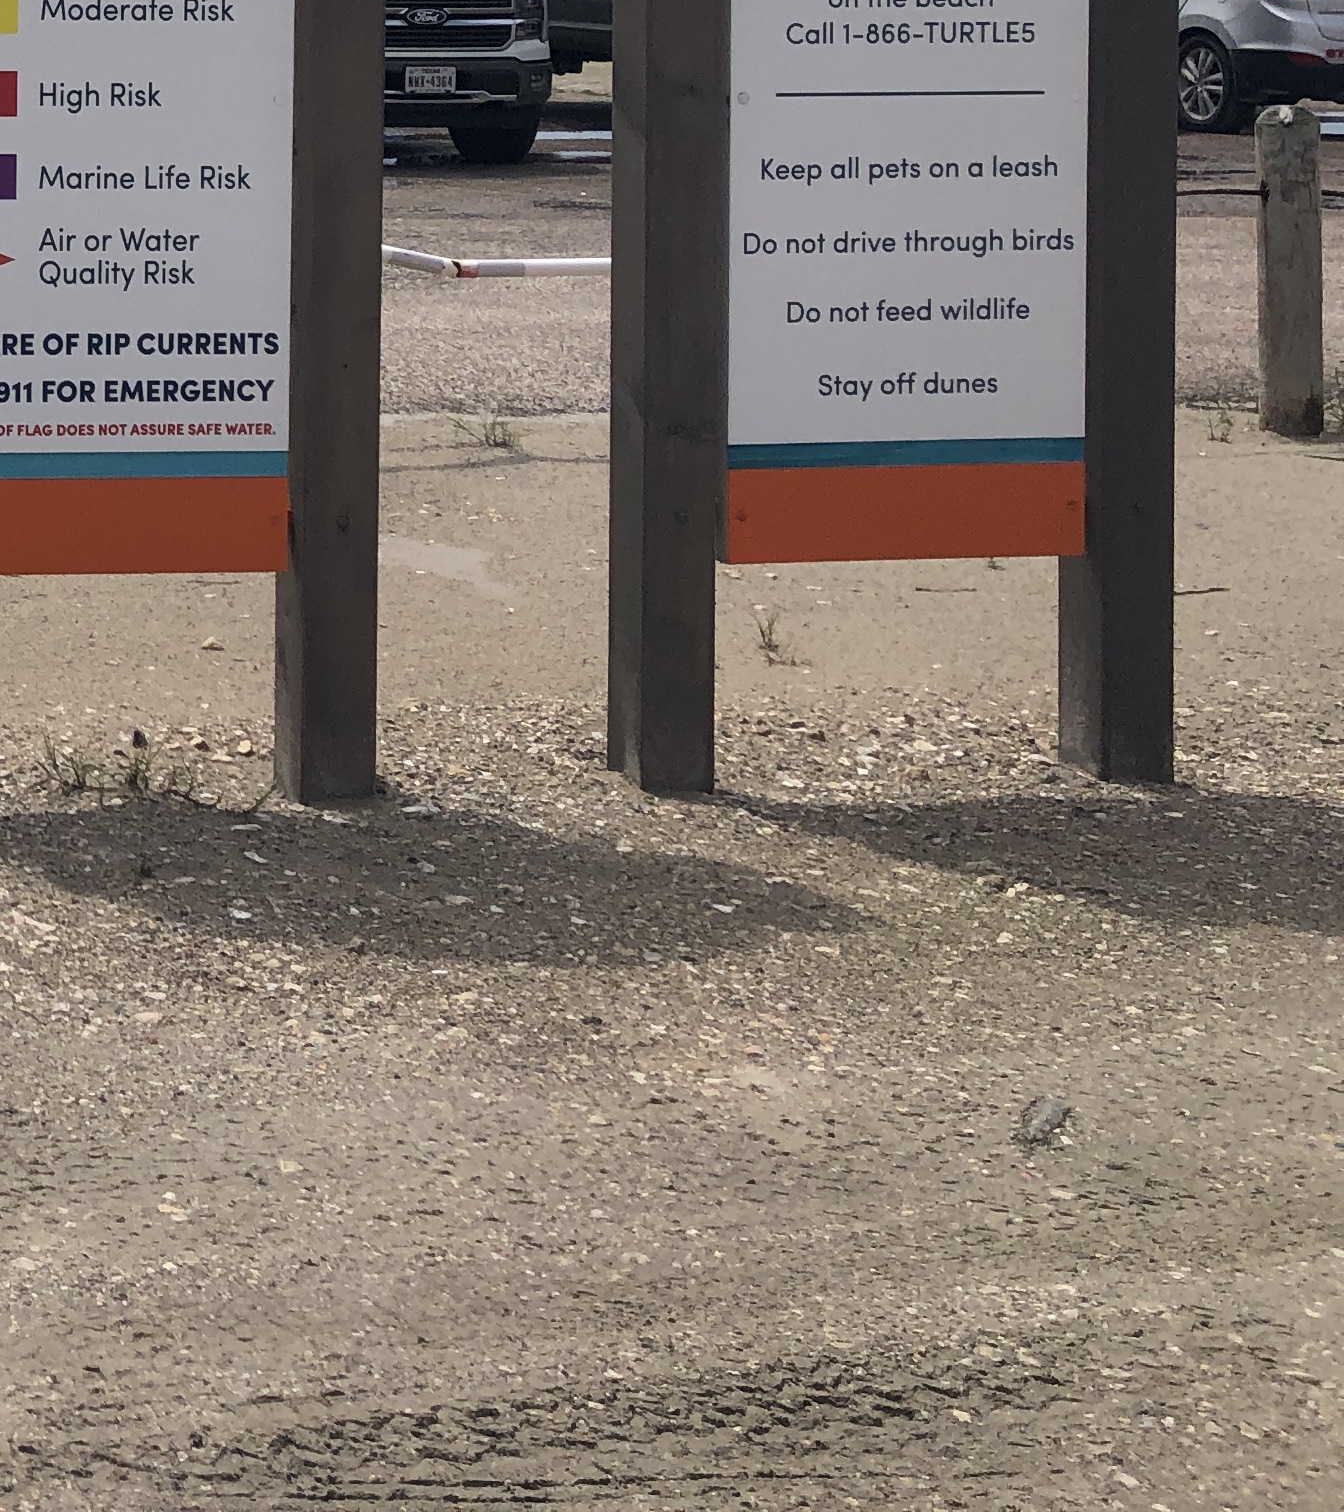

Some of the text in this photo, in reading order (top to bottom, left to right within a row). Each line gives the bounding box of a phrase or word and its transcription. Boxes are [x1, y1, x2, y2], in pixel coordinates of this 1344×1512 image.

[414, 9, 440, 22] Ford
[786, 21, 1035, 45] Call 1-866-TURTLE5
[39, 81, 162, 114] High Risk
[38, 164, 252, 190] Marine Life Risk
[760, 154, 1058, 187] Keep all pets on a leash
[38, 227, 200, 252] Air or Water
[743, 227, 1075, 258] Do not drive through birds
[38, 259, 196, 292] Quality Risk
[786, 296, 1030, 324] Do not feed wildlife
[42, 332, 80, 356] OF
[87, 332, 131, 356] RIP
[136, 332, 280, 356] CURRENTS
[42, 380, 96, 403] FOR
[104, 379, 275, 403] EMERGENCY
[818, 371, 998, 402] Stay off dunes
[17, 424, 53, 437] FLAG
[56, 423, 95, 437] DOES
[98, 423, 128, 437] NOT
[129, 423, 185, 436] ASSURE
[187, 423, 223, 436] SAFE
[224, 422, 276, 436] WATER.
